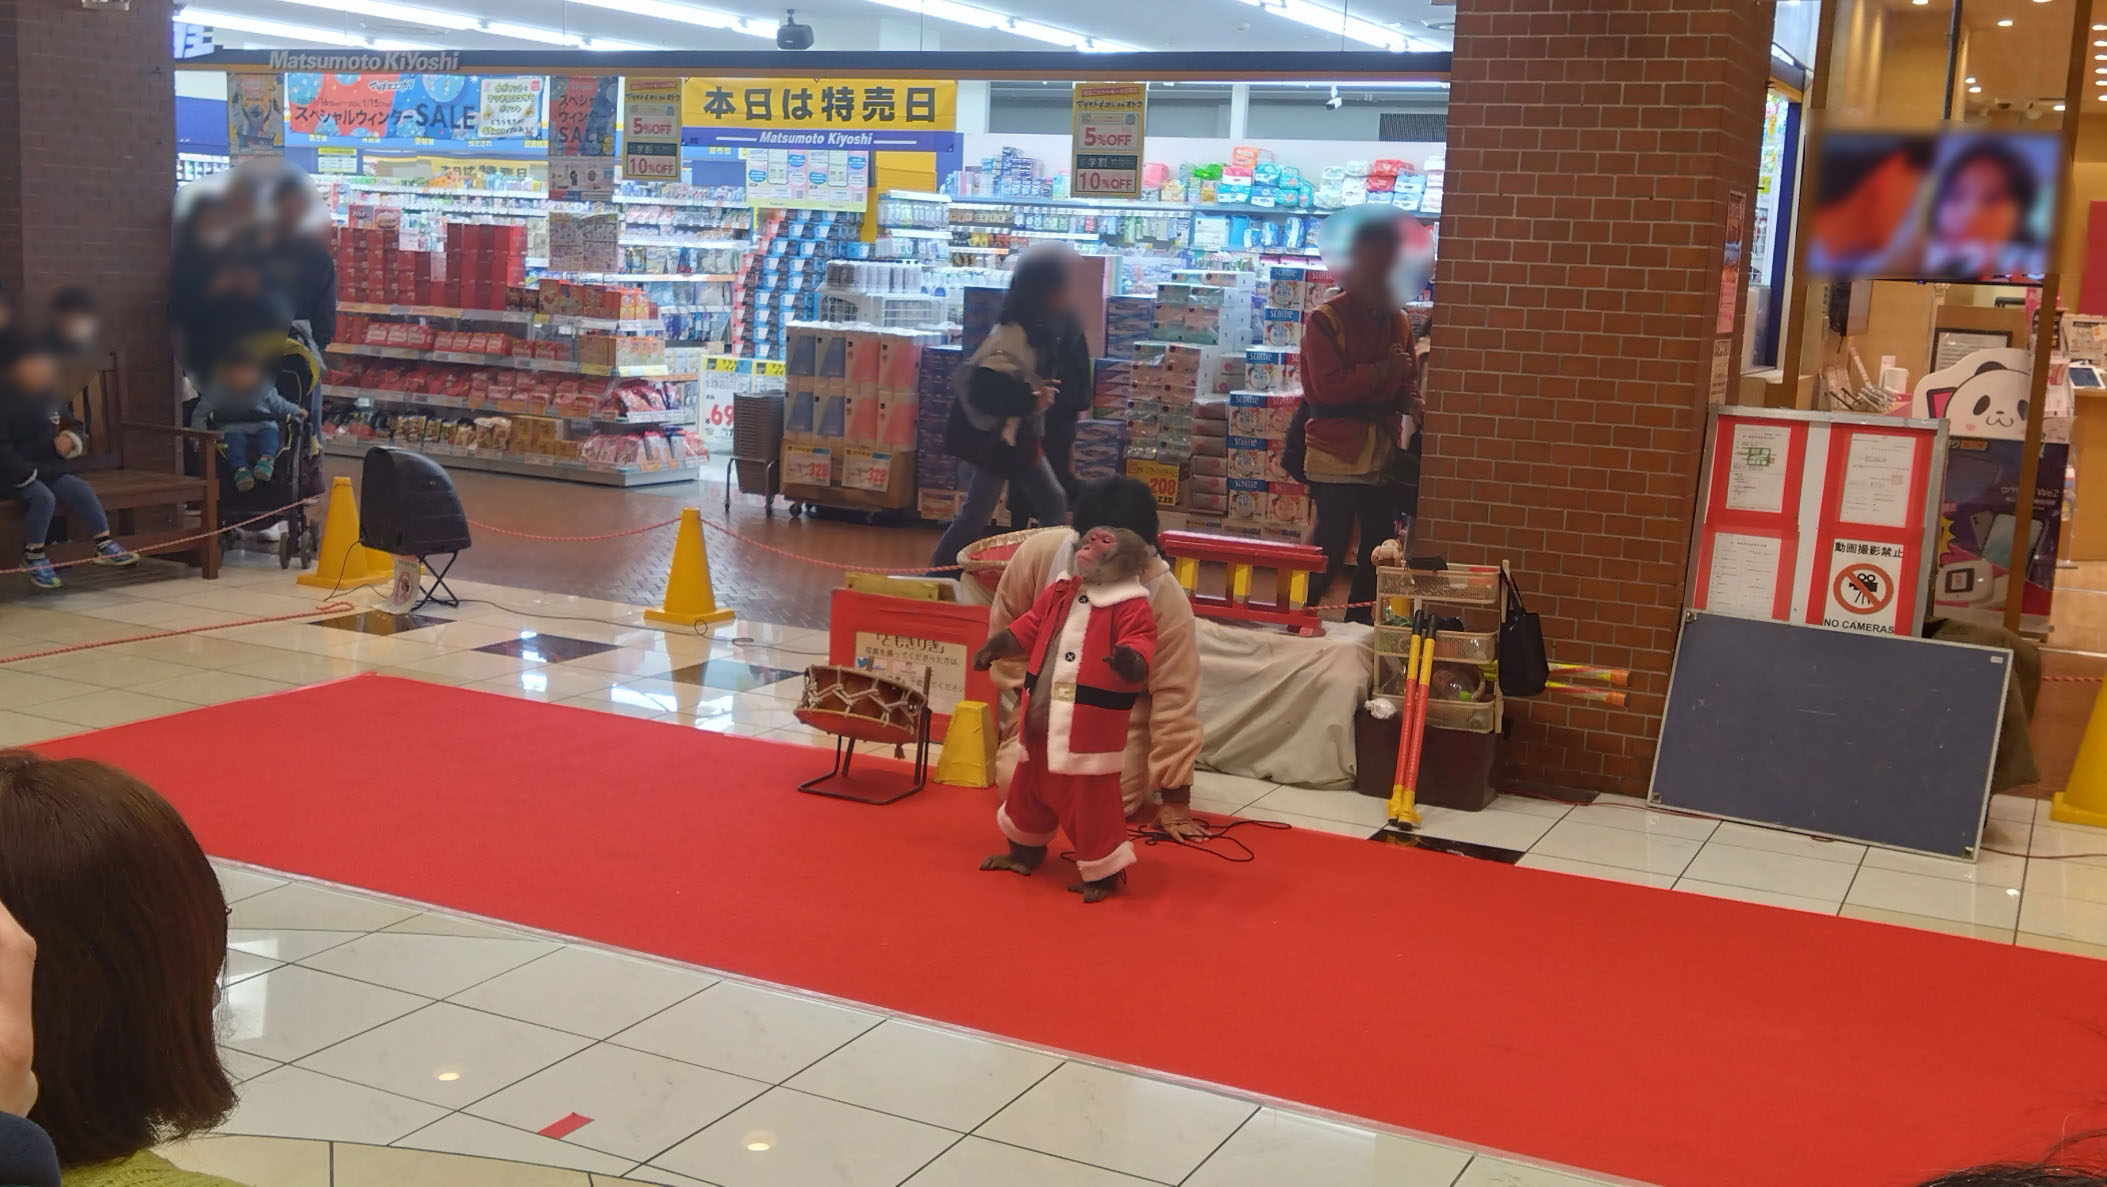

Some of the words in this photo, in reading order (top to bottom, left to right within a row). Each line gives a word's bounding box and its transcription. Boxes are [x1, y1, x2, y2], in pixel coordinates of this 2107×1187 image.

[269, 50, 382, 70] Matsumoto
[703, 85, 936, 122] 本日は特売日
[632, 117, 673, 135] 5%OFF
[759, 131, 825, 145] Matsumoto
[827, 131, 874, 147] Kiyoshi
[1084, 127, 1132, 146] 5%OFF
[629, 158, 674, 175] 10%OFF
[1078, 171, 1133, 190] 10%OFF
[1149, 477, 1177, 496] 208
[1834, 541, 1904, 559] 動画撮影禁止
[1824, 618, 1840, 628] NO
[1842, 620, 1896, 635] CAMERAS
